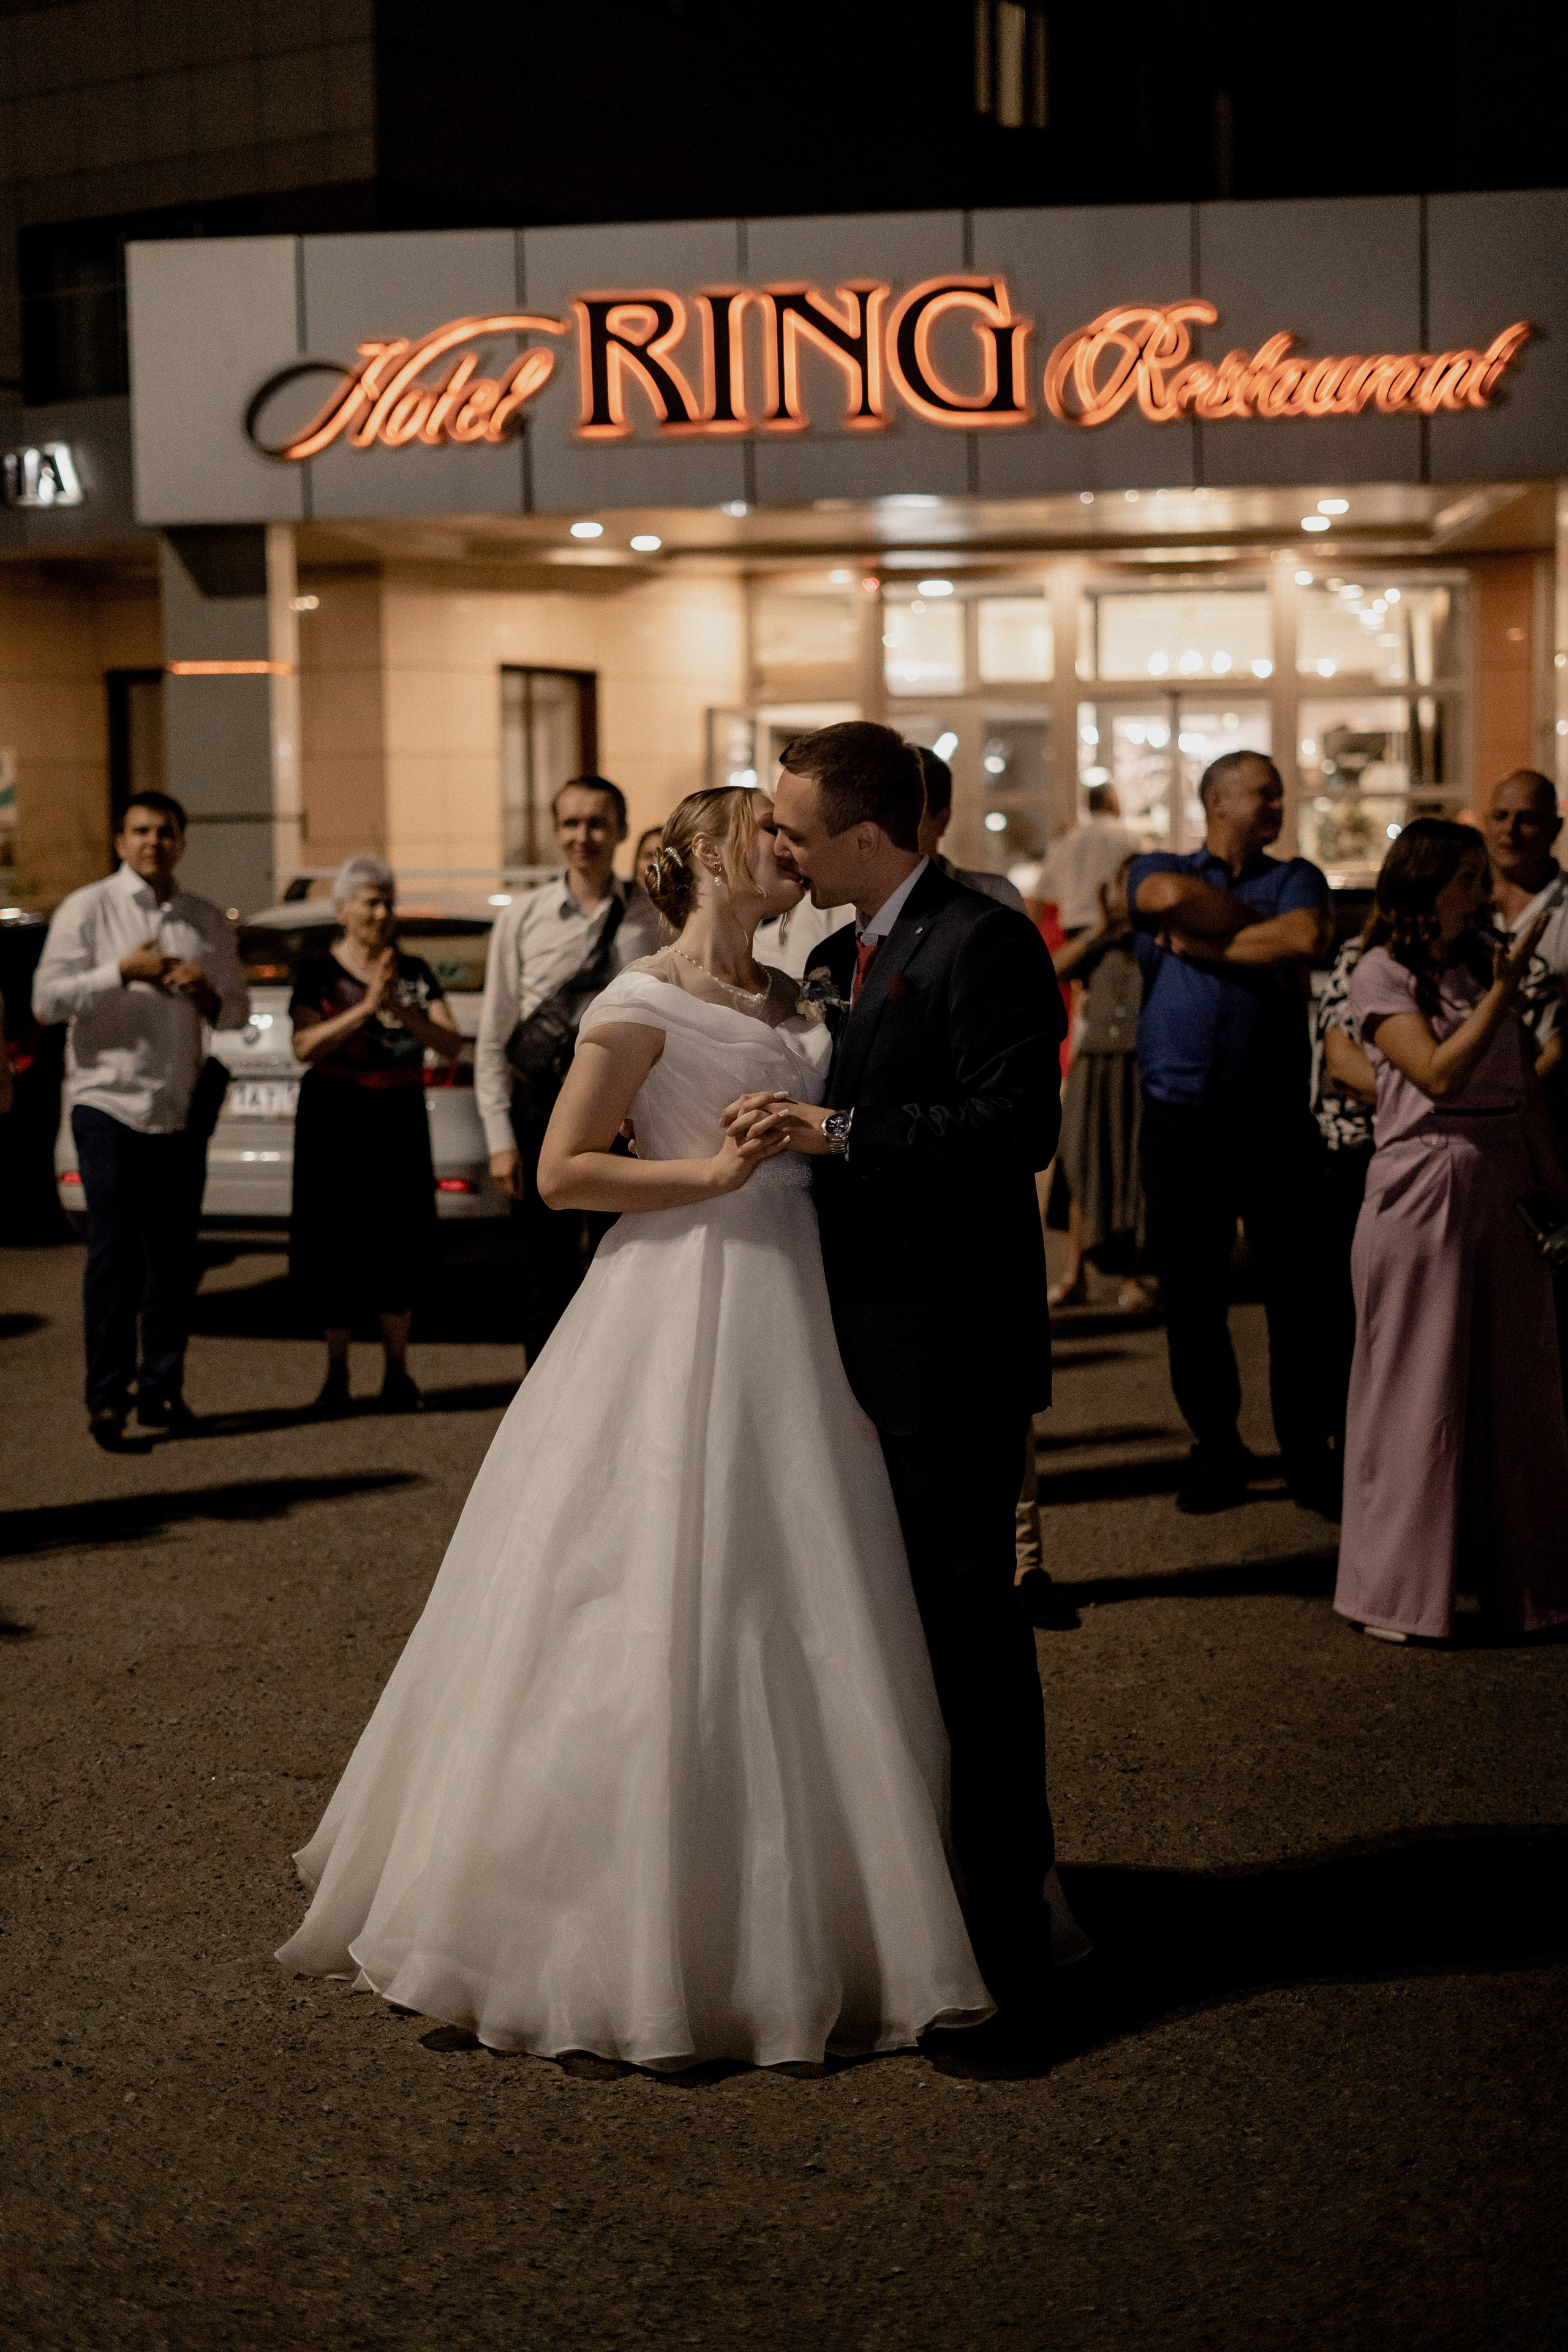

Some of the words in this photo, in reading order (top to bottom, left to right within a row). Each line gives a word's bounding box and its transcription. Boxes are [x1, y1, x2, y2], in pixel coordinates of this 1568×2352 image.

[244, 312, 570, 463] Hotel
[571, 276, 1034, 440] RING
[1043, 299, 1531, 428] Restaurant
